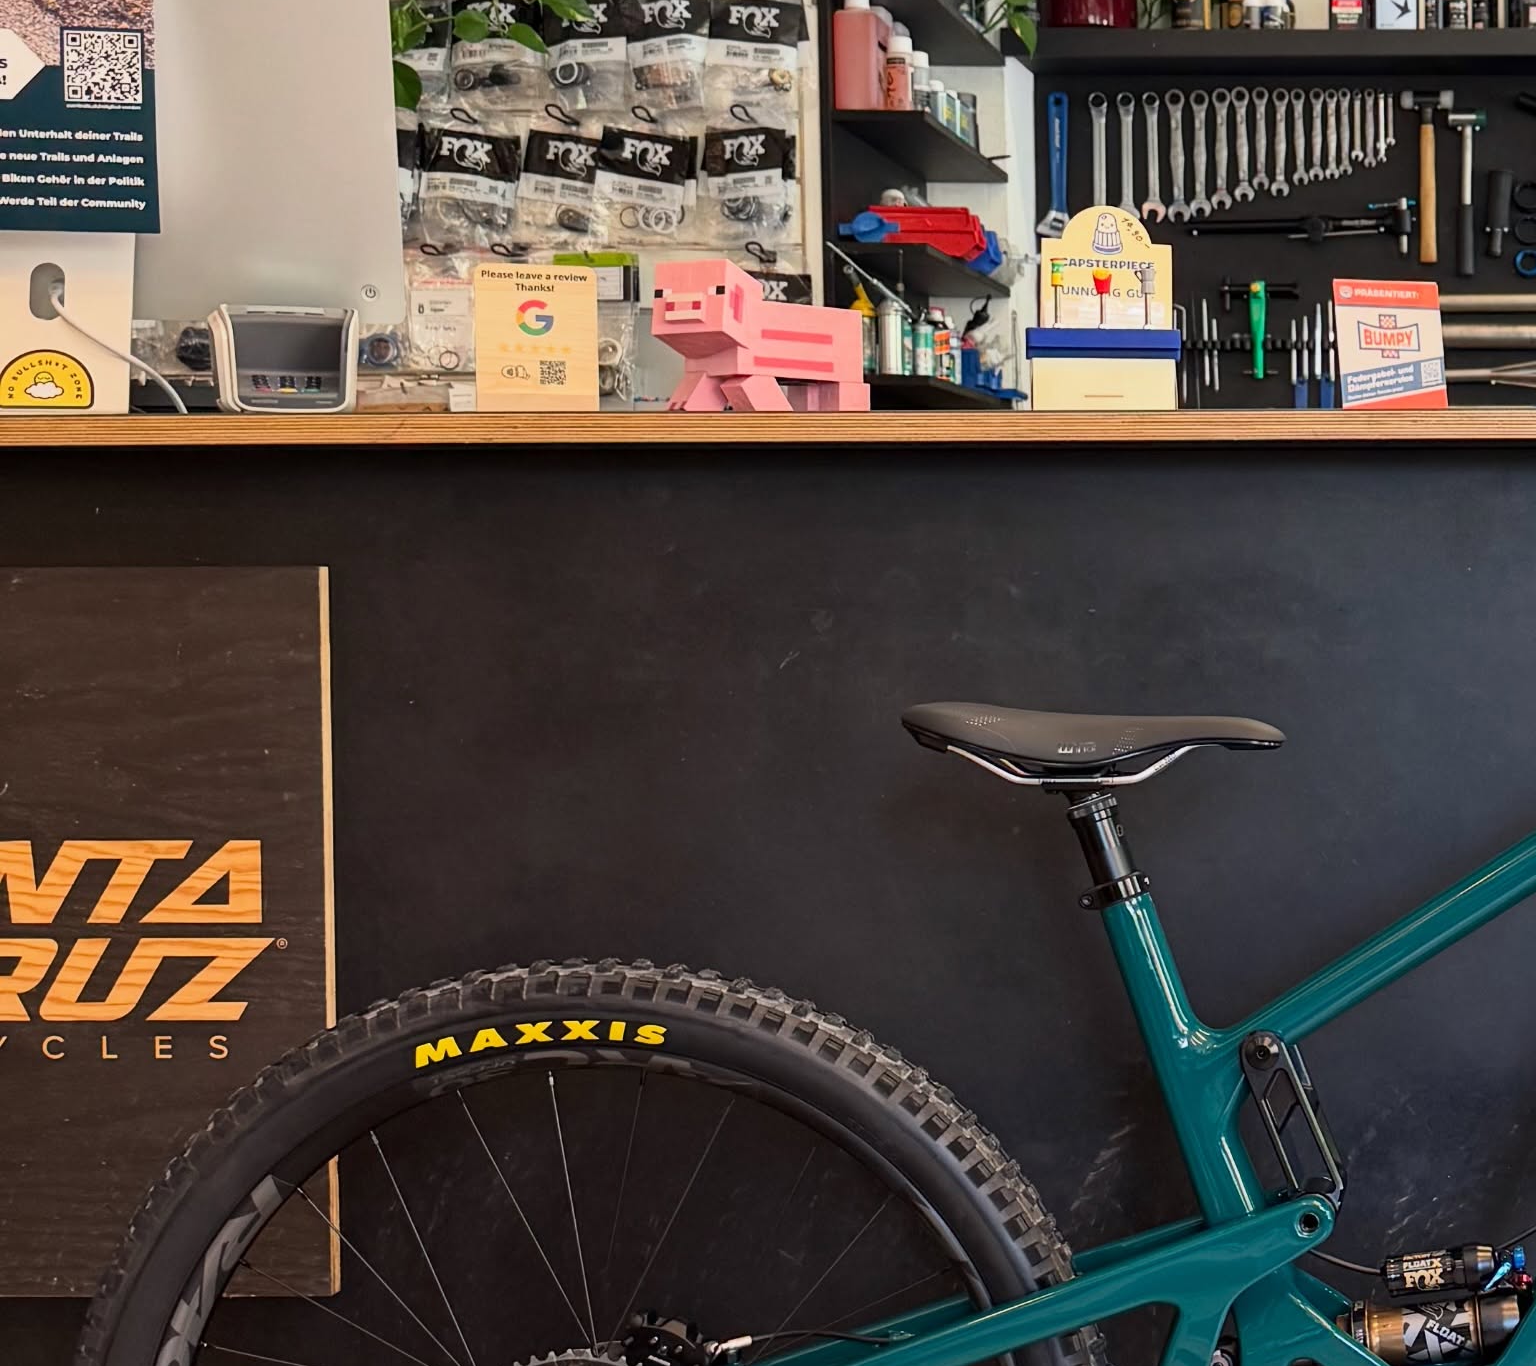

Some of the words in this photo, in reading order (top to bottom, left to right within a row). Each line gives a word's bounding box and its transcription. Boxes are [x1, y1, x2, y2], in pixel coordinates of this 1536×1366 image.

[641, 0, 692, 29] FOX
[729, 6, 780, 38] FOX
[19, 129, 73, 140] Unterhalt
[74, 130, 111, 141] deiner
[113, 131, 144, 142] Trails
[9, 153, 38, 161] neue
[40, 152, 70, 162] Trails
[73, 153, 95, 162] und
[97, 154, 144, 165] Anlagen
[440, 137, 493, 171] FOX
[546, 140, 597, 176] FOX
[622, 137, 673, 175] FOX
[723, 135, 766, 166] FOX
[2, 173, 35, 184] Biken
[37, 174, 72, 185] Gehör
[74, 174, 85, 185] in
[87, 175, 106, 185] der
[108, 175, 145, 186] Politik
[0, 196, 35, 206] Werde
[37, 197, 57, 206] Teil
[59, 197, 79, 207] der
[81, 198, 146, 210] Community
[1062, 257, 1155, 271] CAPSTERPIECE
[481, 270, 514, 280] Please
[516, 271, 543, 281] leave
[554, 273, 588, 282] review
[515, 284, 555, 293] Thanks!
[1363, 329, 1414, 347] BUMPY
[1398, 364, 1415, 374] und
[70, 373, 83, 399] ZONE
[415, 1020, 668, 1069] MAXXIS
[1404, 1268, 1445, 1290] FOX
[1425, 1319, 1466, 1346] FLOAT
